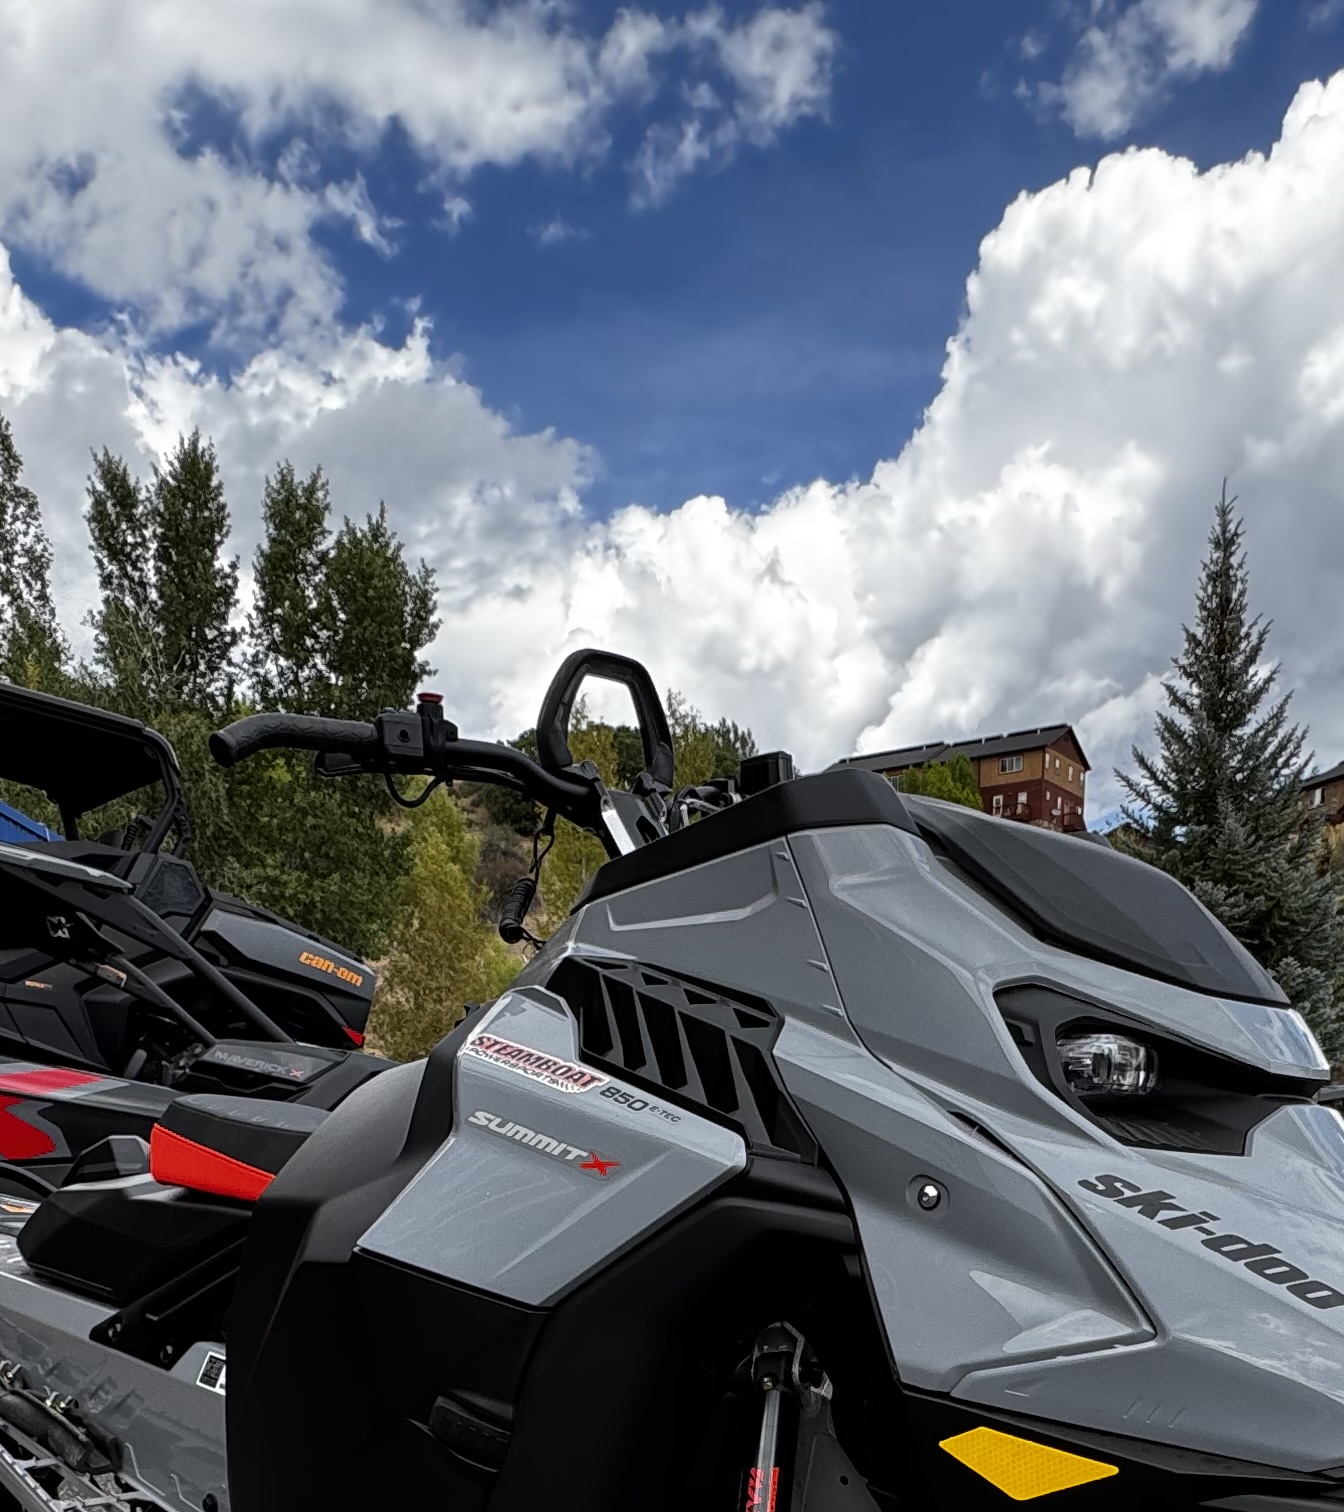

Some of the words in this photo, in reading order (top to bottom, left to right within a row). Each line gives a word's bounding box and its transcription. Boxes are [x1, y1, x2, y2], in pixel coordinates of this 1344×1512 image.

[299, 951, 363, 988] can-am
[469, 1035, 606, 1089] STEAMBOAT
[599, 1086, 650, 1112] 850
[468, 1110, 588, 1161] SUMMIT
[579, 1152, 621, 1177] X
